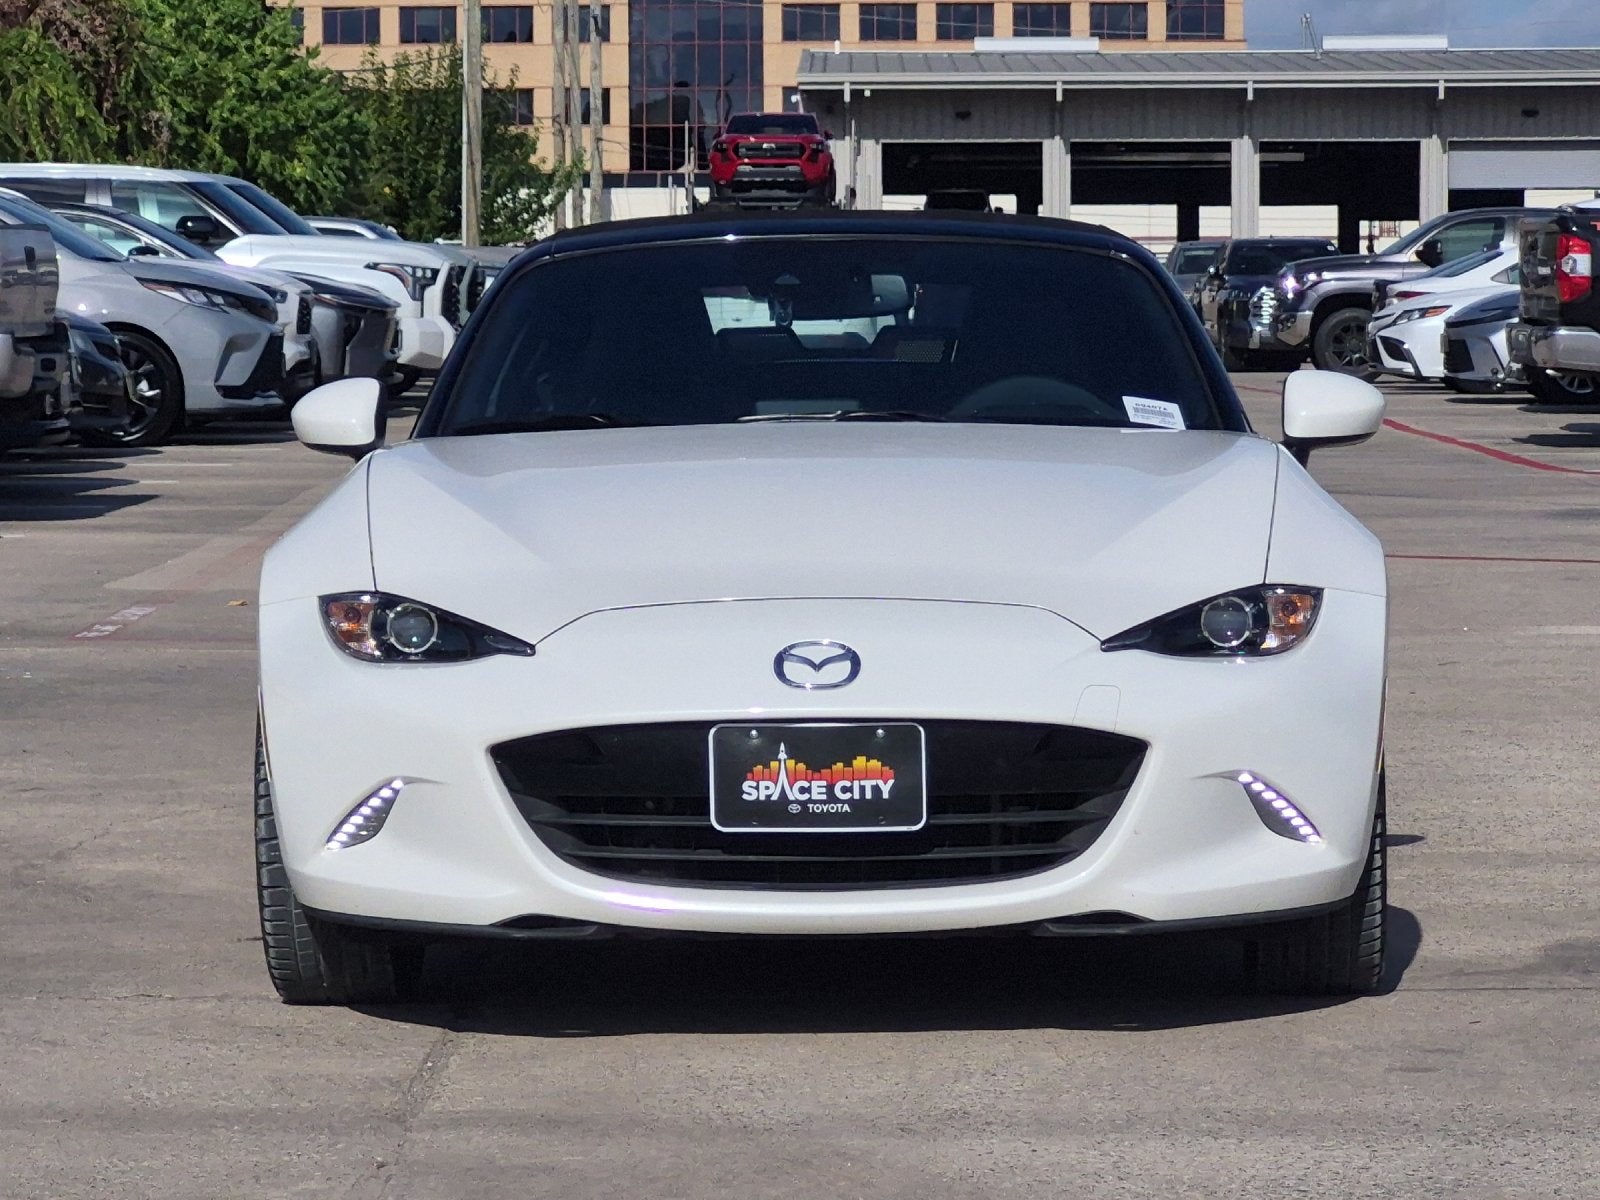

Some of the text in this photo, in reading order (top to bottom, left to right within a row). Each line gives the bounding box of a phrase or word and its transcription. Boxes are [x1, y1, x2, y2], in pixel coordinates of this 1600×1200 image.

[741, 765, 895, 801] SPACE CITY
[807, 804, 851, 813] TOYOTA
